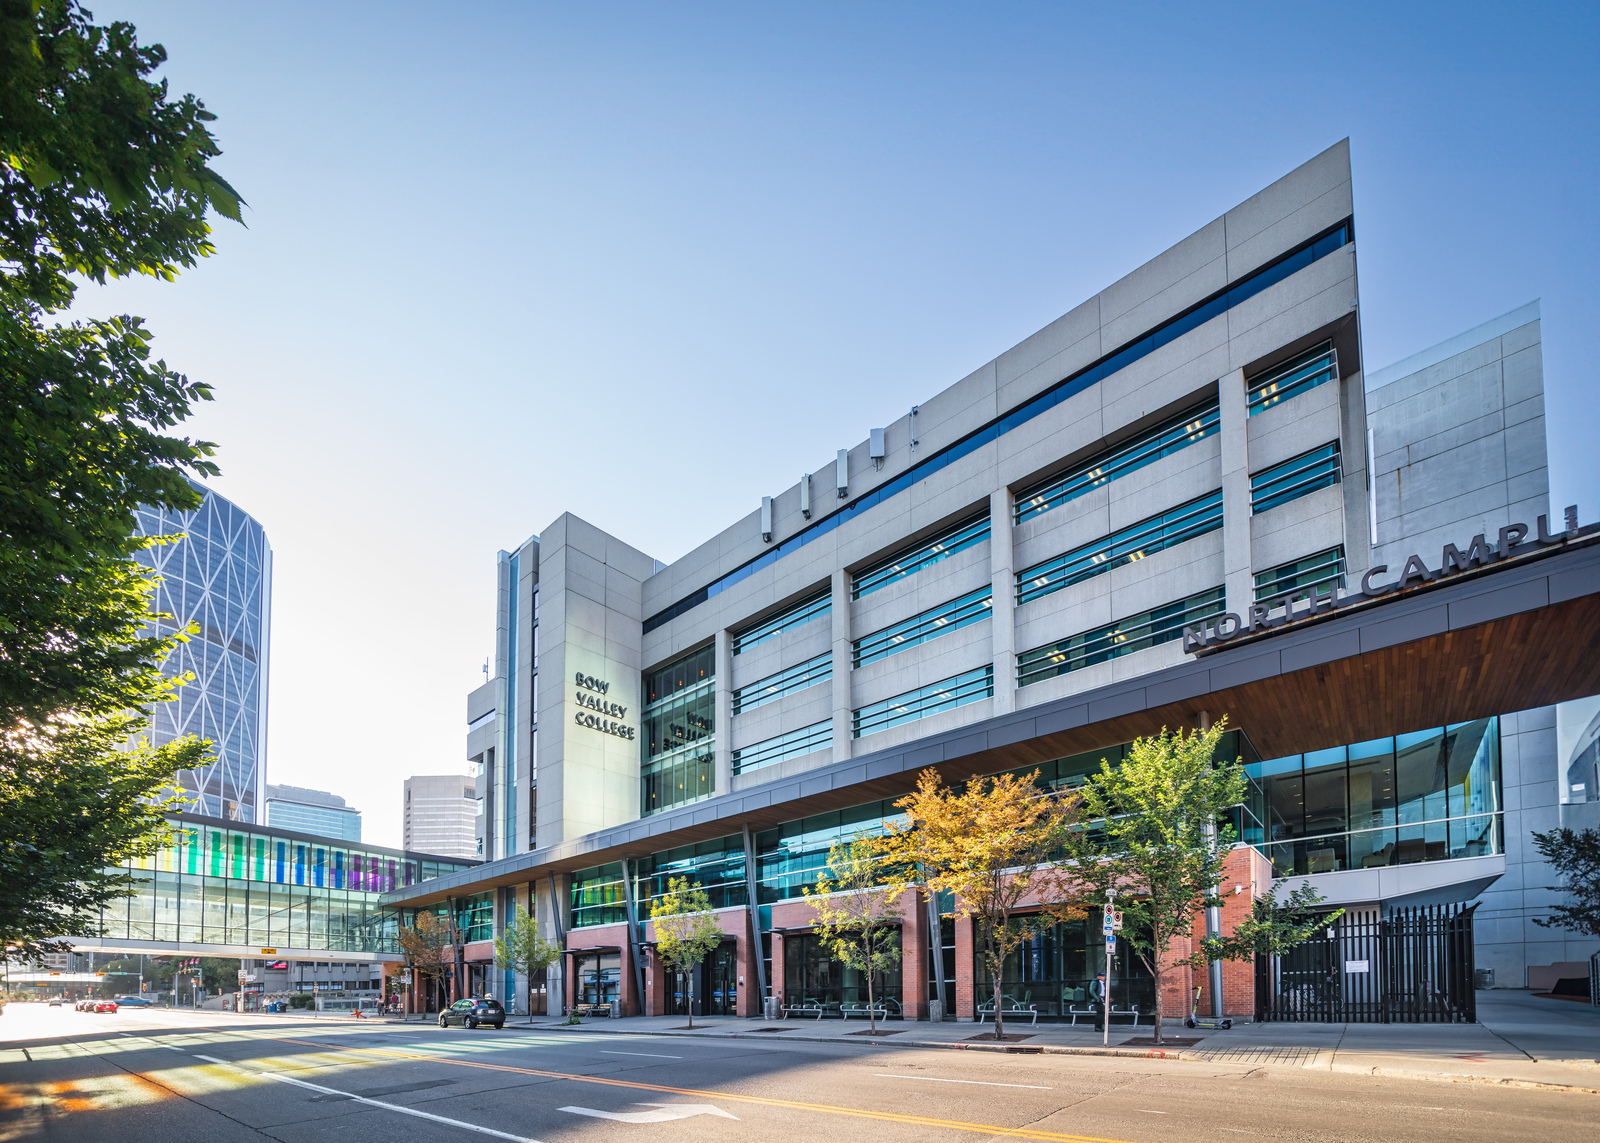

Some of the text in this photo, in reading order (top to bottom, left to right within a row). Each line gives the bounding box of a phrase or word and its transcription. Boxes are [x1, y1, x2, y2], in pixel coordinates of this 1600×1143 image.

[1182, 504, 1578, 654] NORTH CAMPU
[575, 672, 609, 694] BOW
[575, 691, 627, 719] VALLEY
[575, 711, 635, 740] COLLEGE
